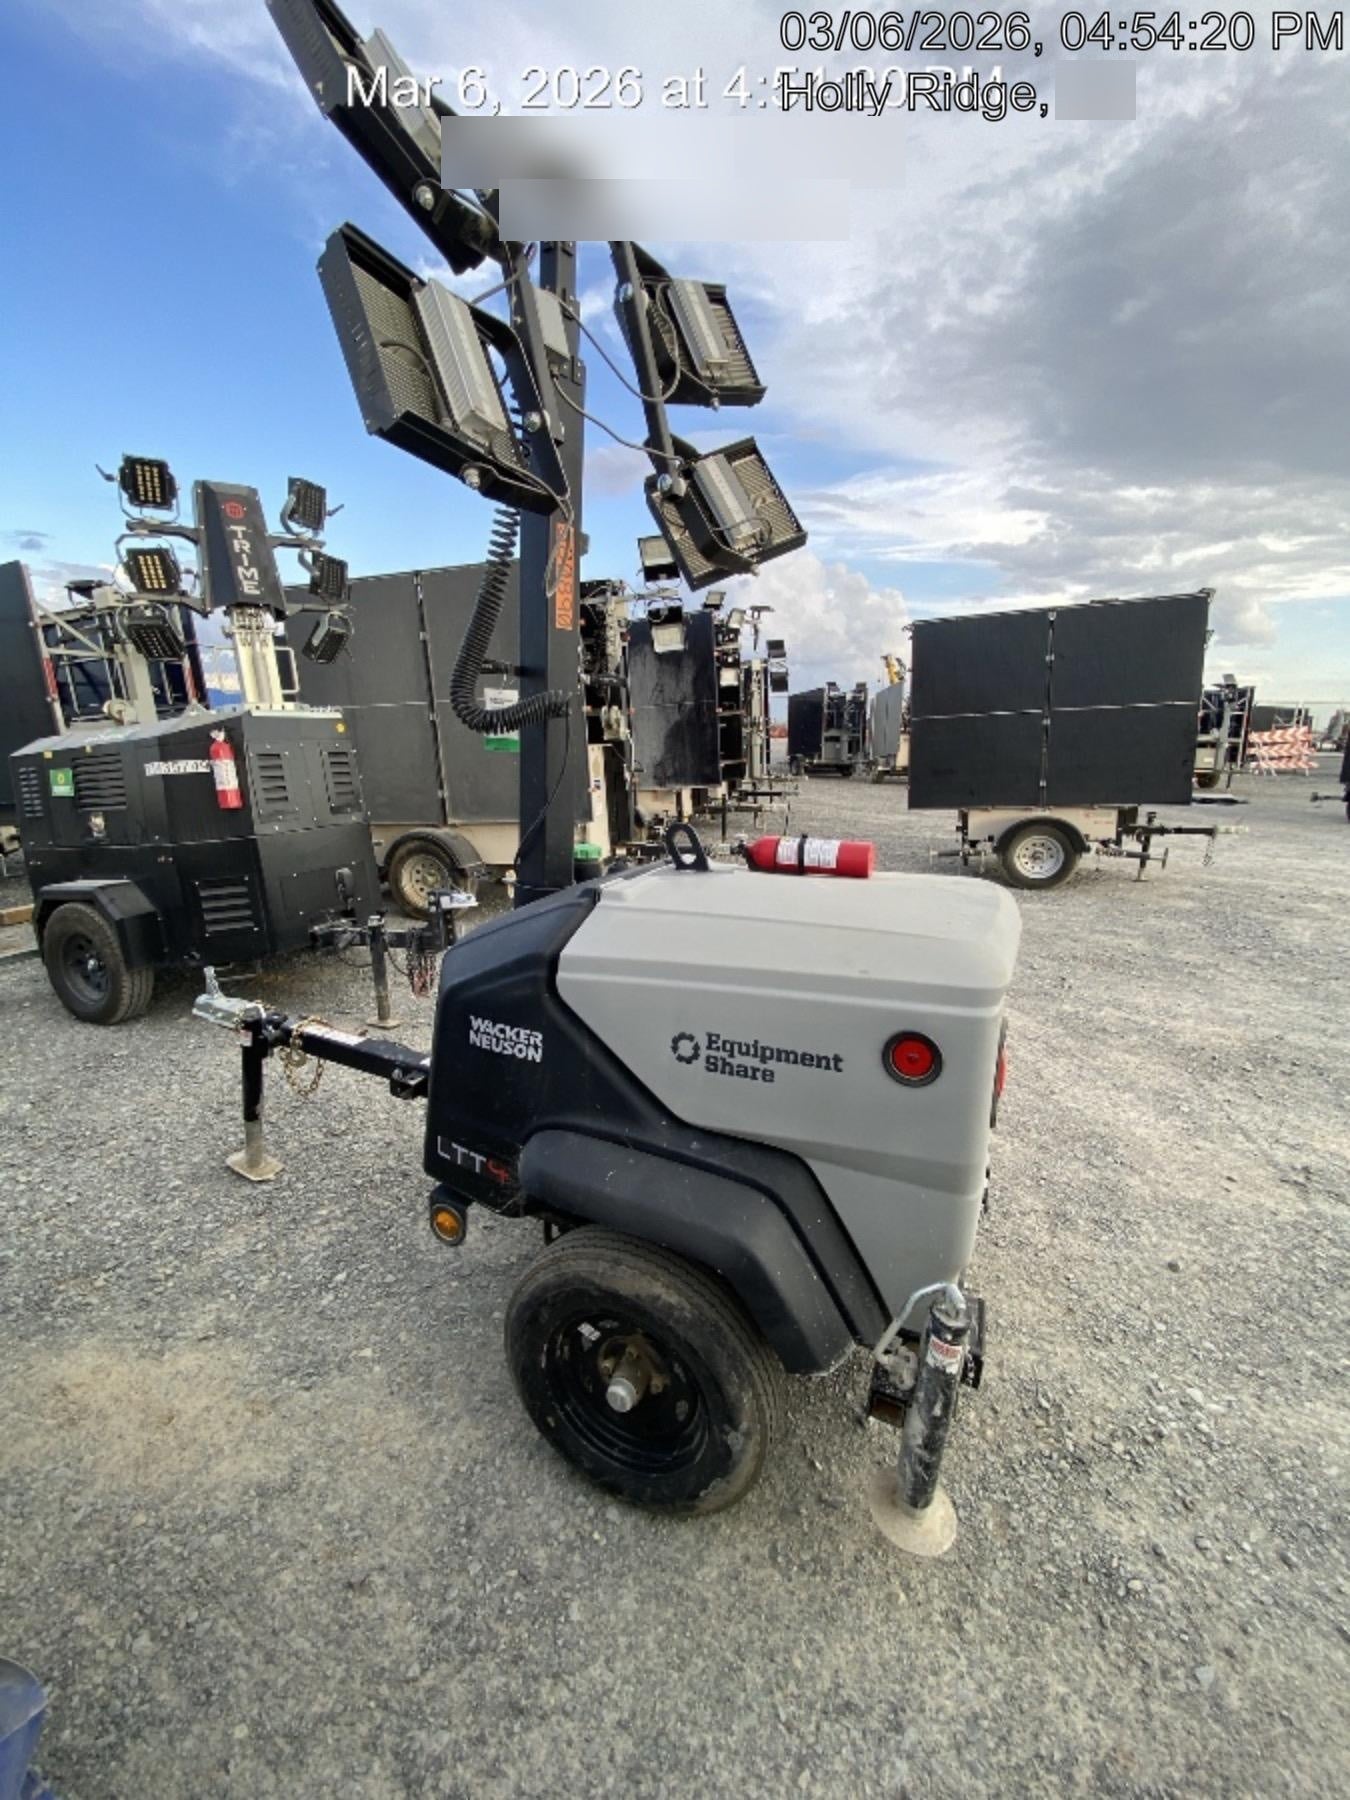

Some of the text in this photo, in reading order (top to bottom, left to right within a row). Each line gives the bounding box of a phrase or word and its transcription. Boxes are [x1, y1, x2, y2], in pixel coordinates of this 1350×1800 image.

[229, 525, 261, 595] TRIME
[469, 1015, 543, 1047] WACKER
[469, 1029, 543, 1063] NEUSON
[704, 1054, 775, 1083] Share
[705, 1031, 844, 1073] Equipment
[437, 1135, 509, 1184] LTT4
